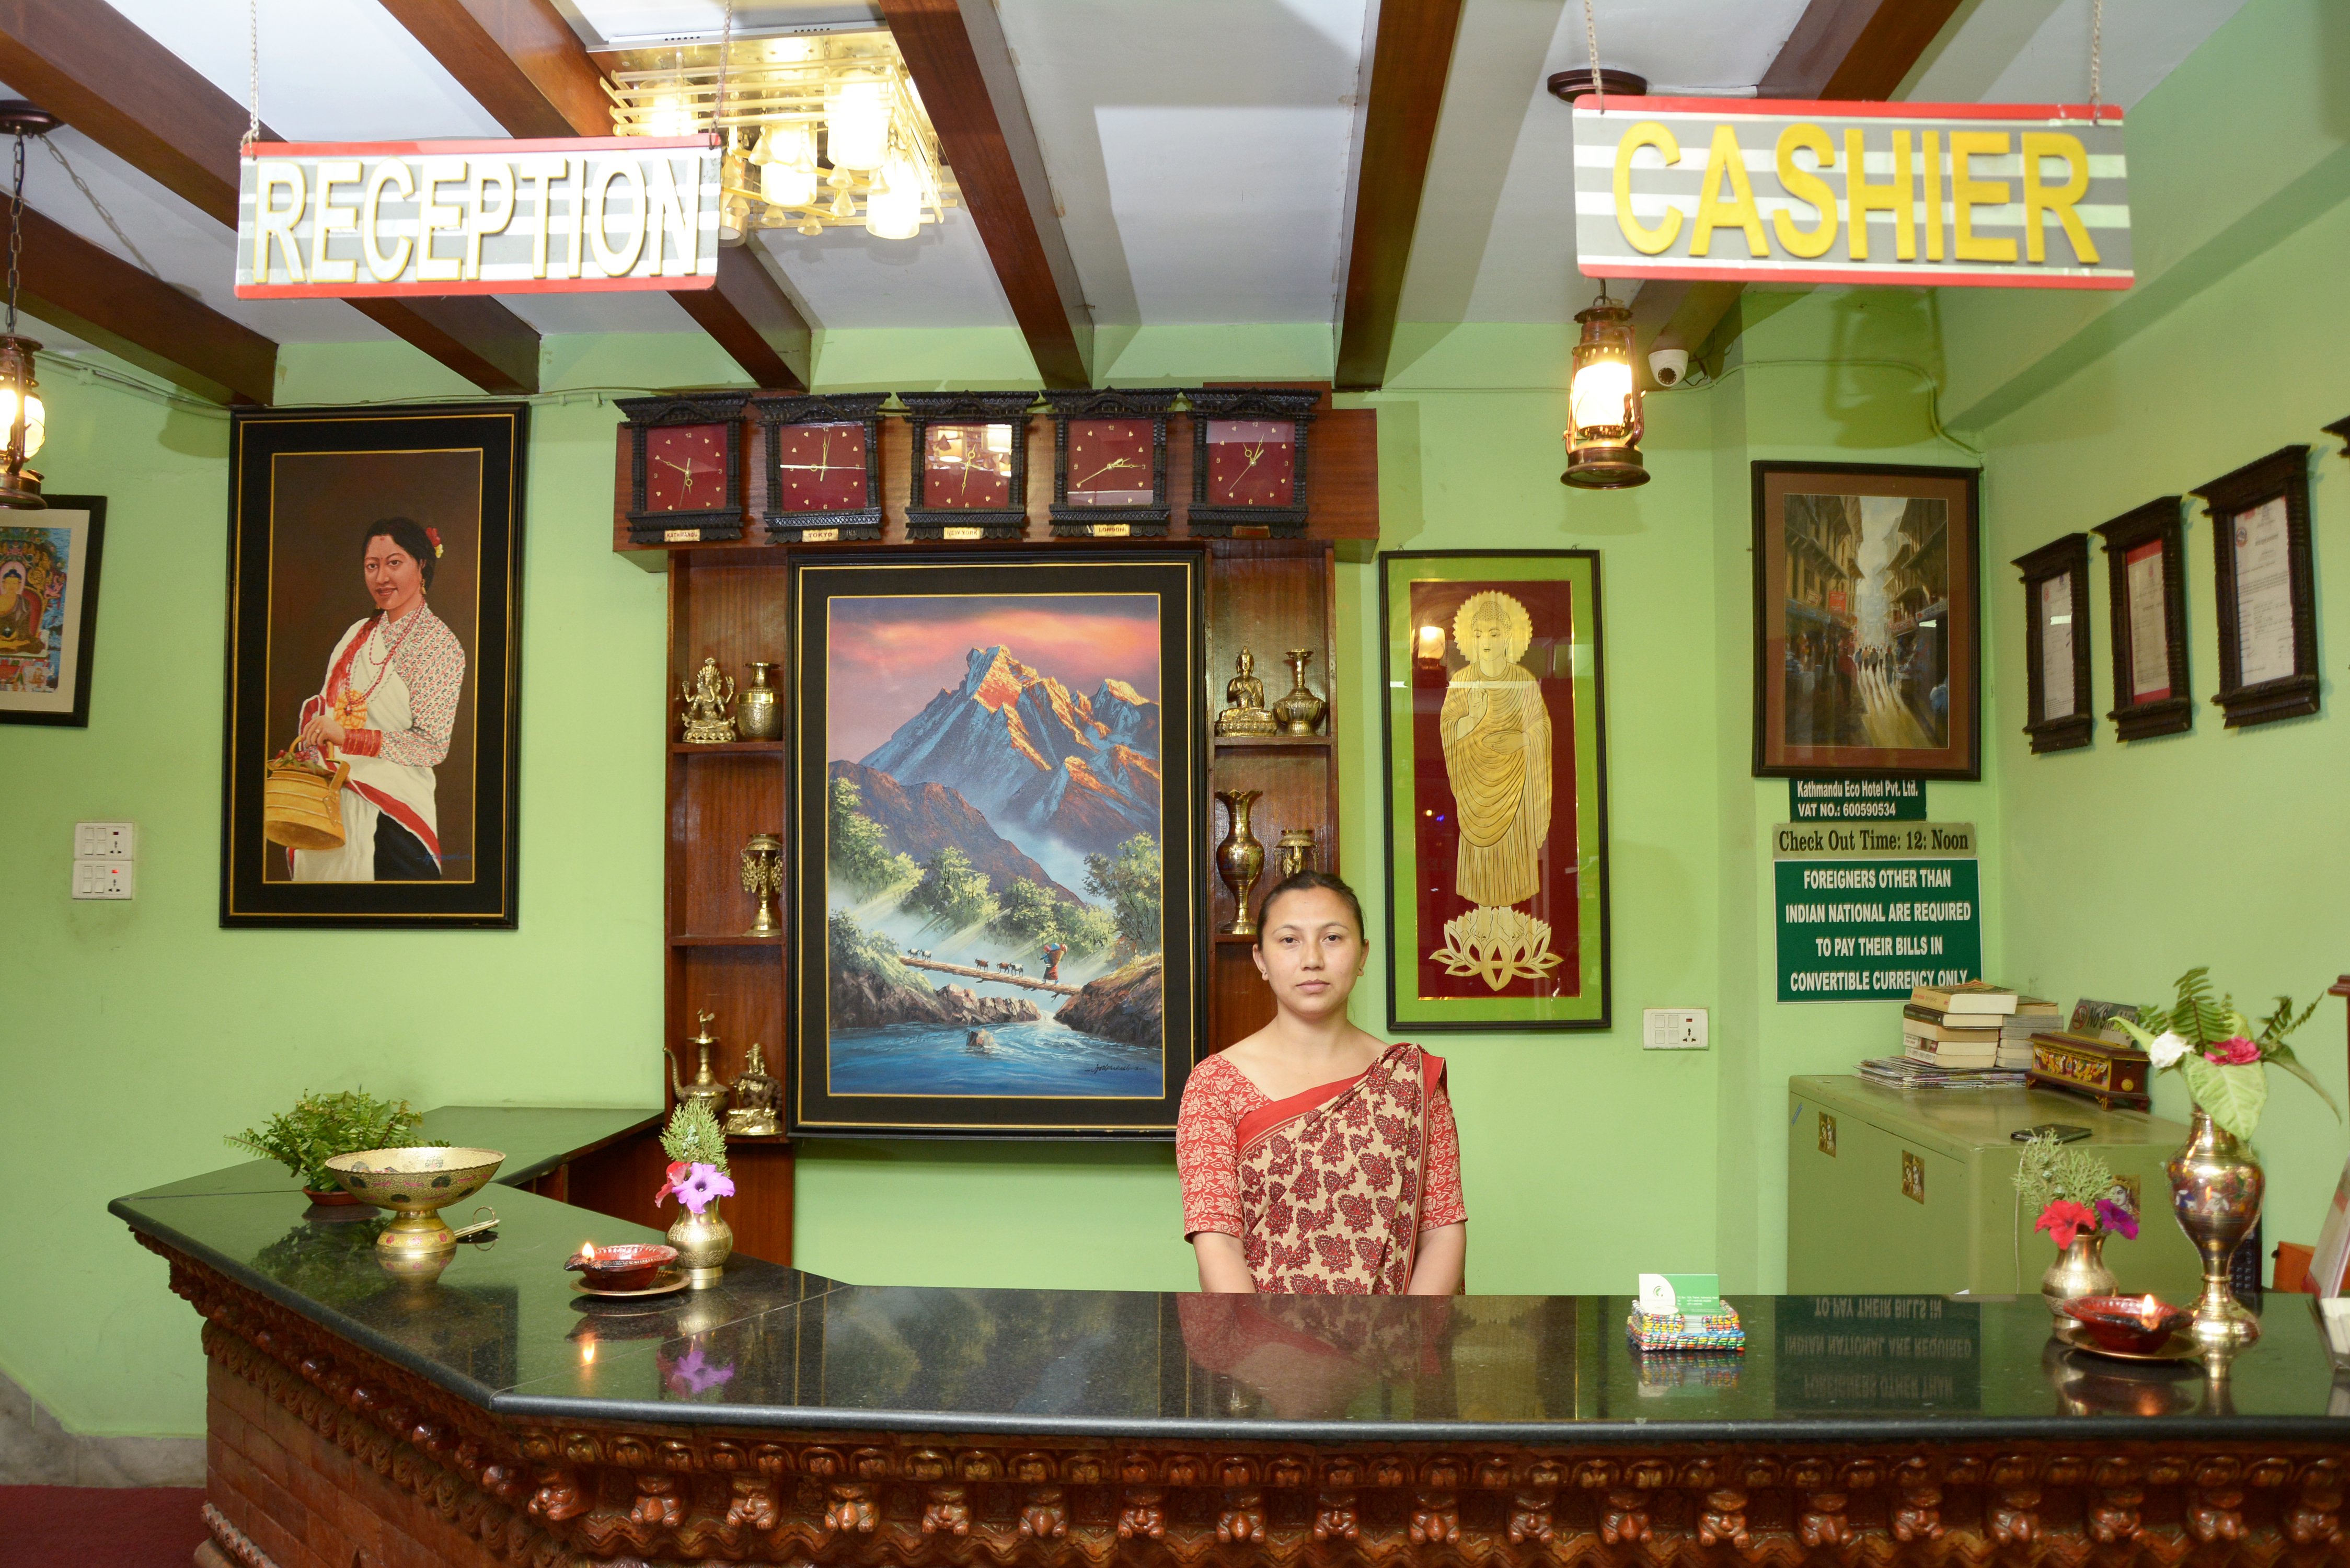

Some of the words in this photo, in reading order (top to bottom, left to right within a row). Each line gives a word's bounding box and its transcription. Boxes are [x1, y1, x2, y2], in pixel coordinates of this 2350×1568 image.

[1612, 121, 2100, 263] CASHIER
[254, 156, 701, 282] RECEPTION
[1797, 780, 1842, 798] Kathmandu
[1845, 780, 1860, 797] Eco
[1862, 780, 1883, 797] Hotel
[1885, 780, 1901, 797] Pvt.
[1903, 779, 1918, 797] Ltd.
[1798, 803, 1817, 817] VAT
[1820, 803, 1840, 816] NO.:
[1843, 802, 1896, 816] 600590534
[1779, 830, 1824, 851] Check
[1829, 829, 1855, 851] Out
[1860, 829, 1901, 850] Time:
[1906, 831, 1927, 850] 12:
[1931, 829, 1969, 850] Noon
[1804, 870, 1876, 889] FOREIGNERS
[1879, 869, 1917, 888] OTHER
[1920, 869, 1951, 887] THAN
[1785, 904, 1825, 923] INDIAN
[1828, 904, 1885, 923] NATIONAL
[1888, 903, 1911, 921] ARE
[1914, 903, 1971, 922] REQUIRED
[1816, 938, 1831, 956] TO
[1835, 938, 1855, 956] PAY
[1858, 937, 1893, 956] THEIR
[1896, 937, 1928, 955] BILLS
[1931, 937, 1942, 955] IN
[1790, 972, 1870, 991] CONVERTIBLE
[1873, 971, 1934, 990] CURRENCY
[1938, 970, 1967, 987] ONLY
[2086, 1006, 2099, 1029] No
